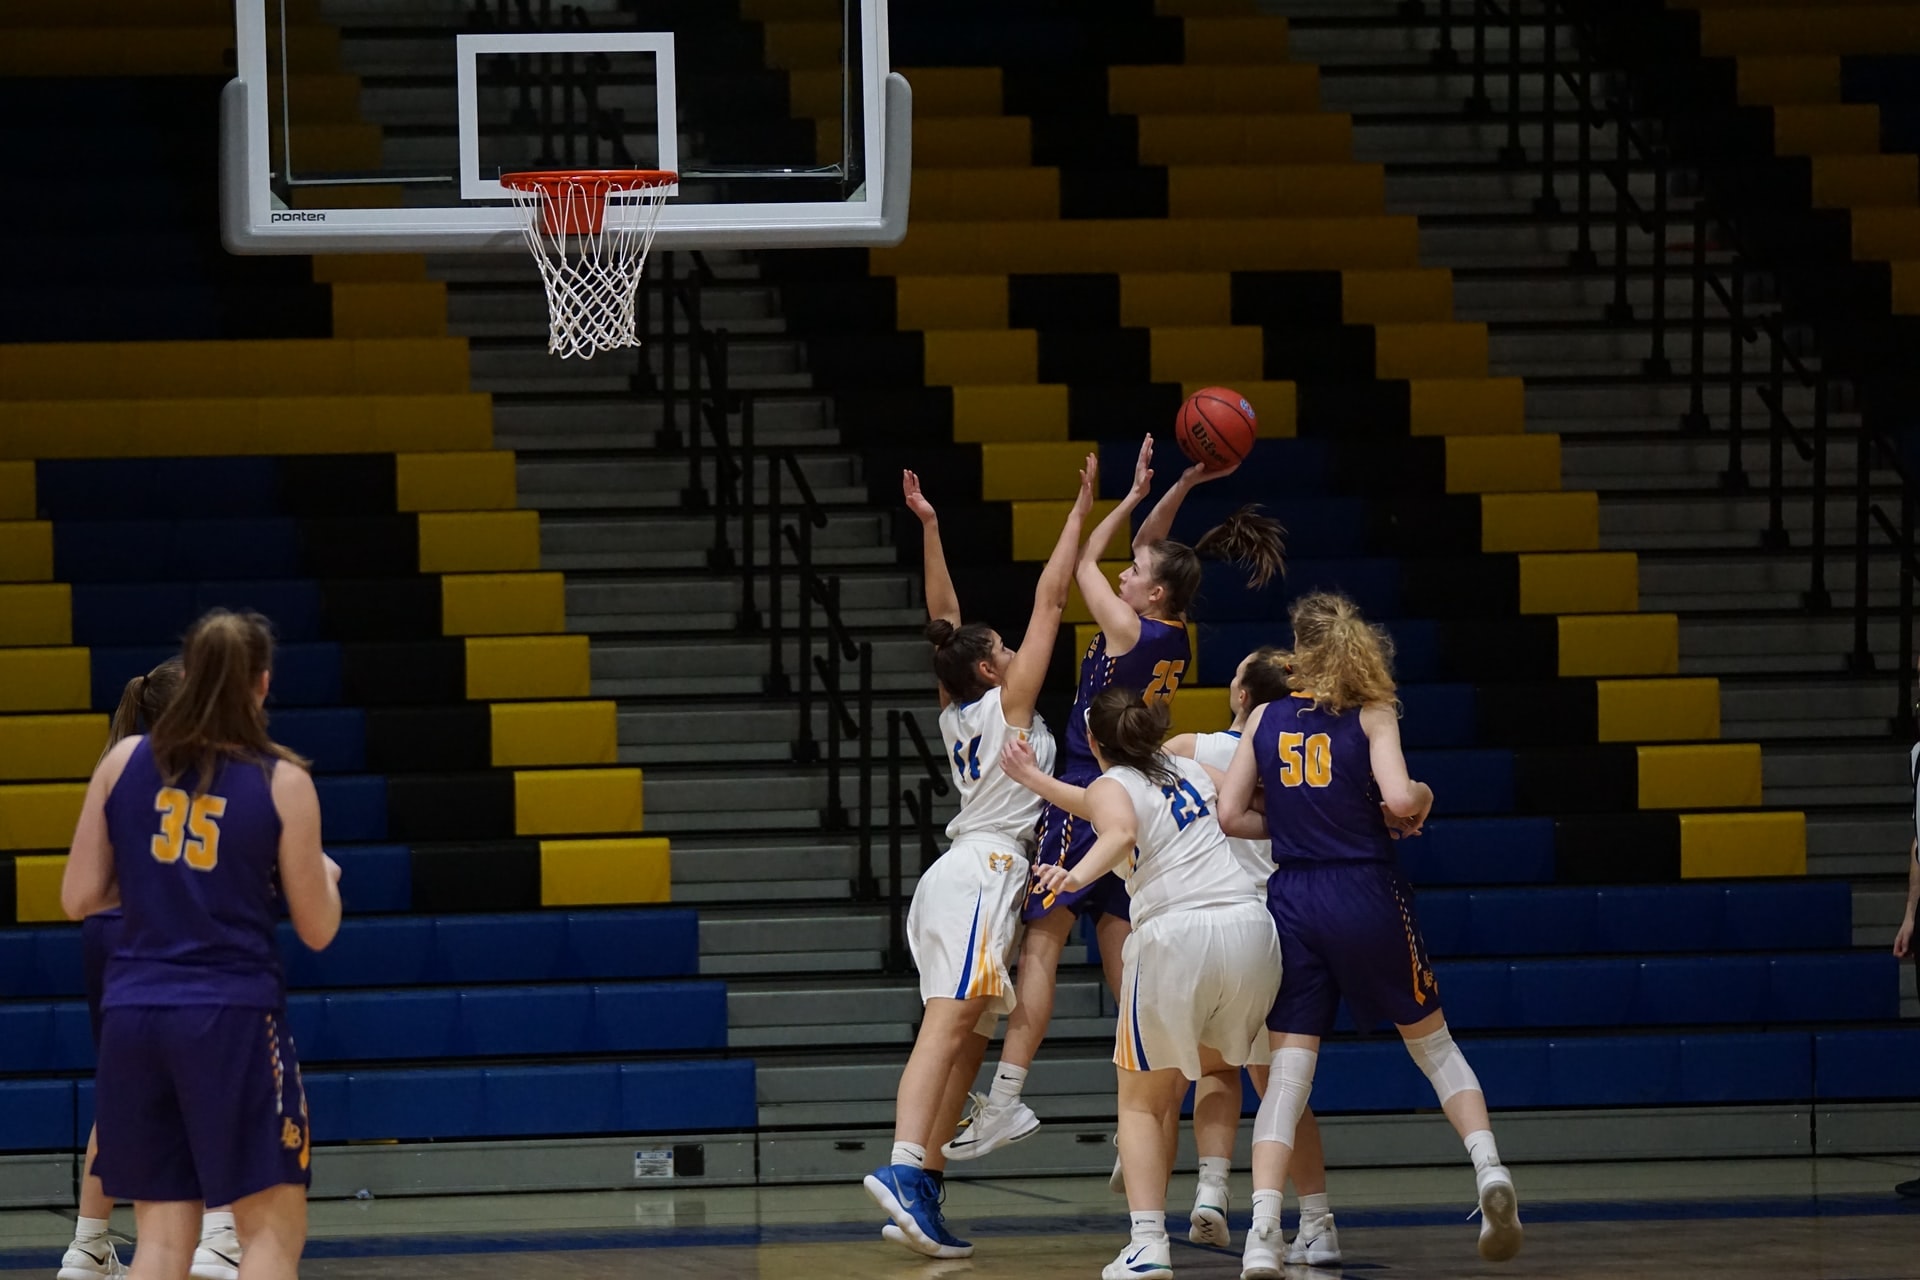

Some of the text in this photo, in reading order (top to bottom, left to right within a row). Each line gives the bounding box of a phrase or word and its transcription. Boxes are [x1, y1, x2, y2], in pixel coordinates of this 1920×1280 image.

[1142, 659, 1185, 709] 25
[1278, 731, 1333, 788] 50
[151, 786, 228, 872] 35
[1161, 778, 1210, 832] 21
